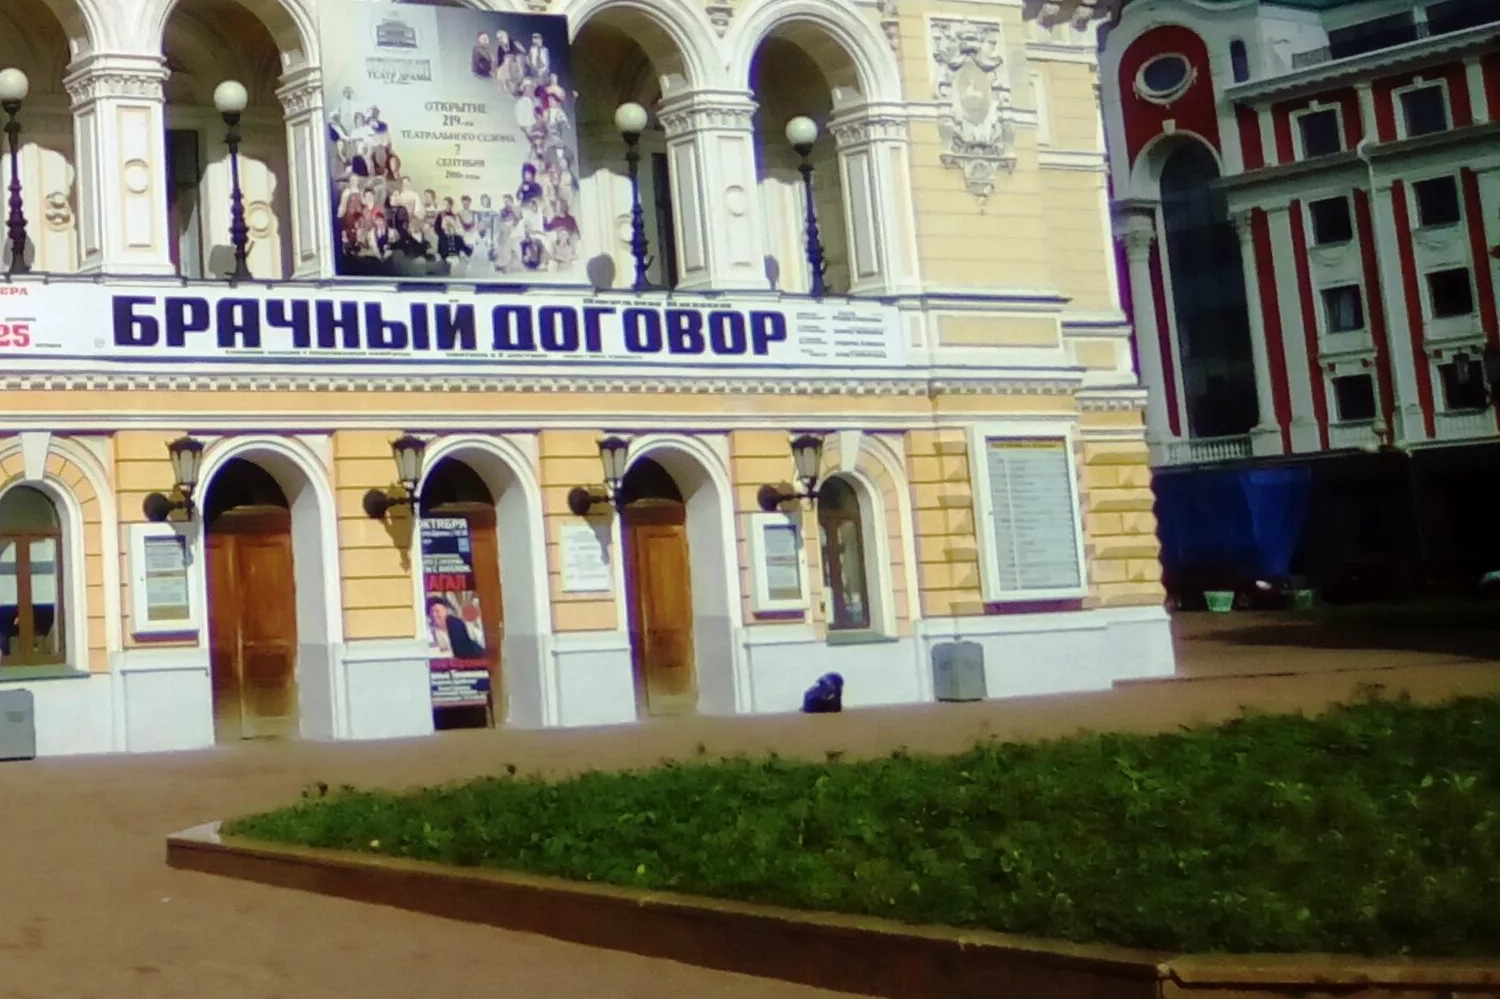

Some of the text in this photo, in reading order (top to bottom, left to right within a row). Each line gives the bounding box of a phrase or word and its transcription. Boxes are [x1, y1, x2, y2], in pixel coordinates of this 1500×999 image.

[424, 101, 488, 114] ОТКРЫТИЕ
[401, 130, 475, 141] ТЕАТРАЛЬНОГО
[112, 295, 477, 351] БРАЧНЫЙ
[492, 304, 787, 355] ДОГОВОР
